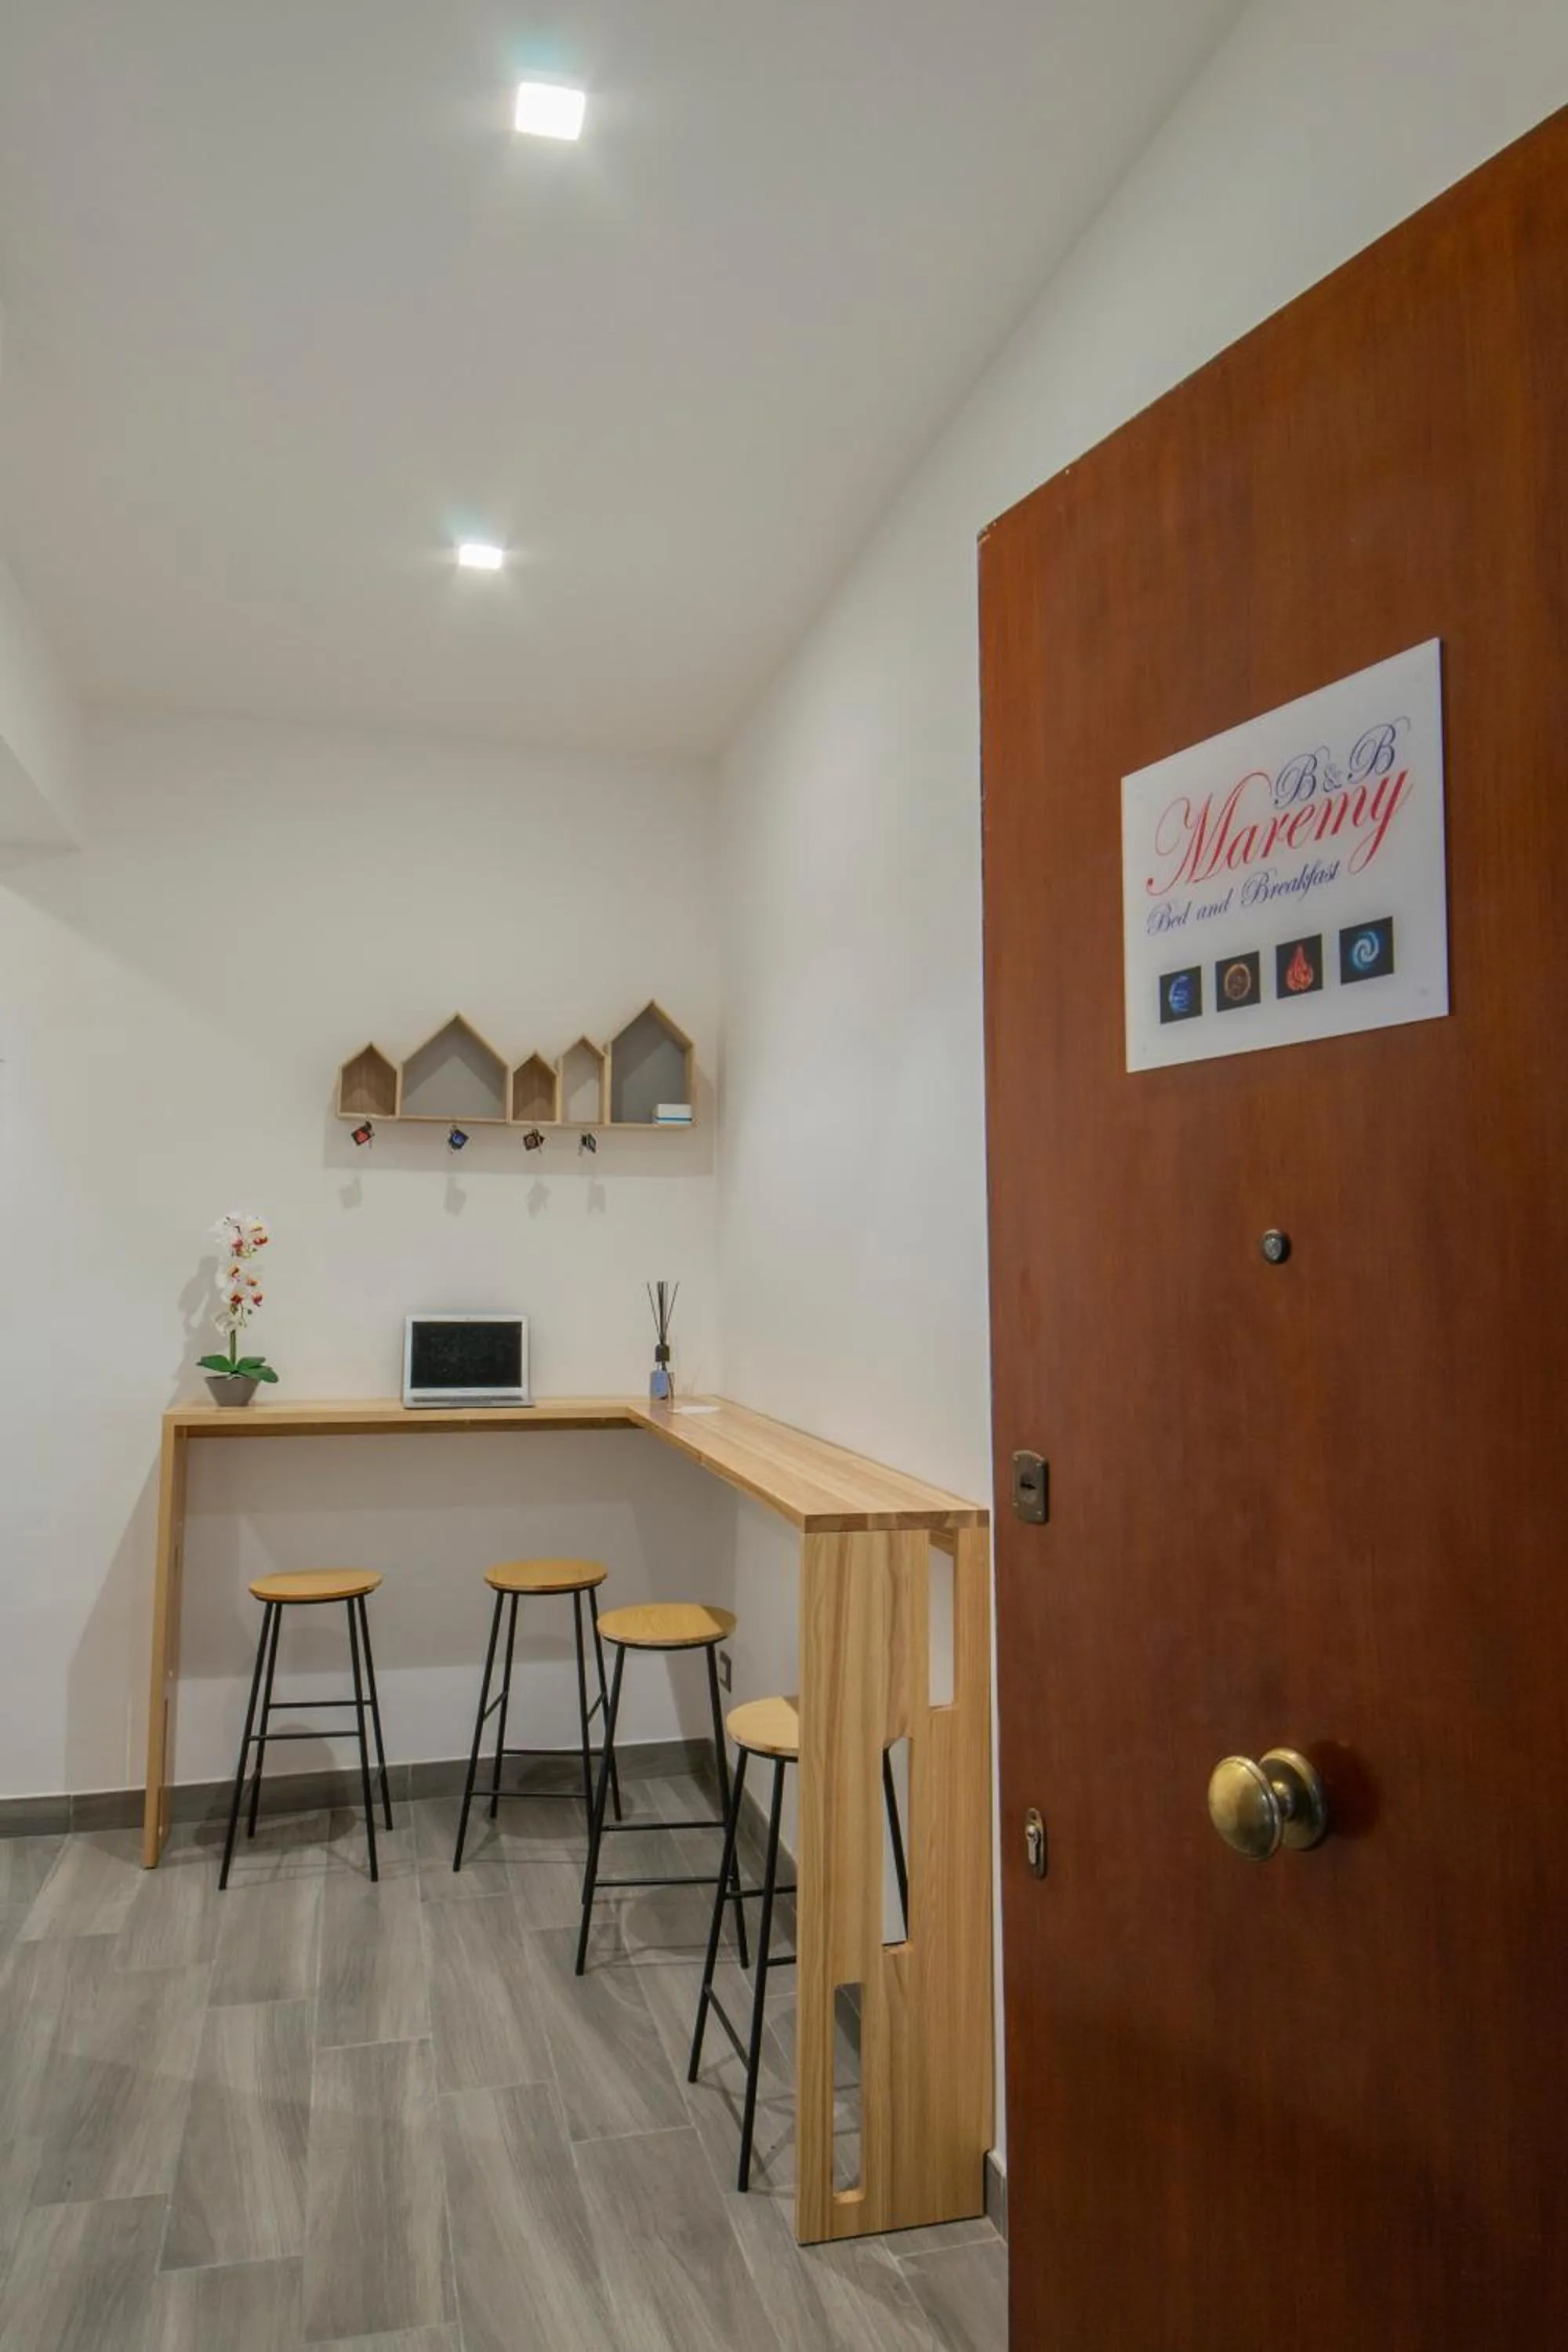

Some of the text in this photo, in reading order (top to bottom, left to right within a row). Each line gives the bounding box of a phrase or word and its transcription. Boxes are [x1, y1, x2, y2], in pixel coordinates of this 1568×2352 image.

[1146, 770, 1413, 895] Maremy
[1146, 859, 1341, 935] Bed and Breakfast
